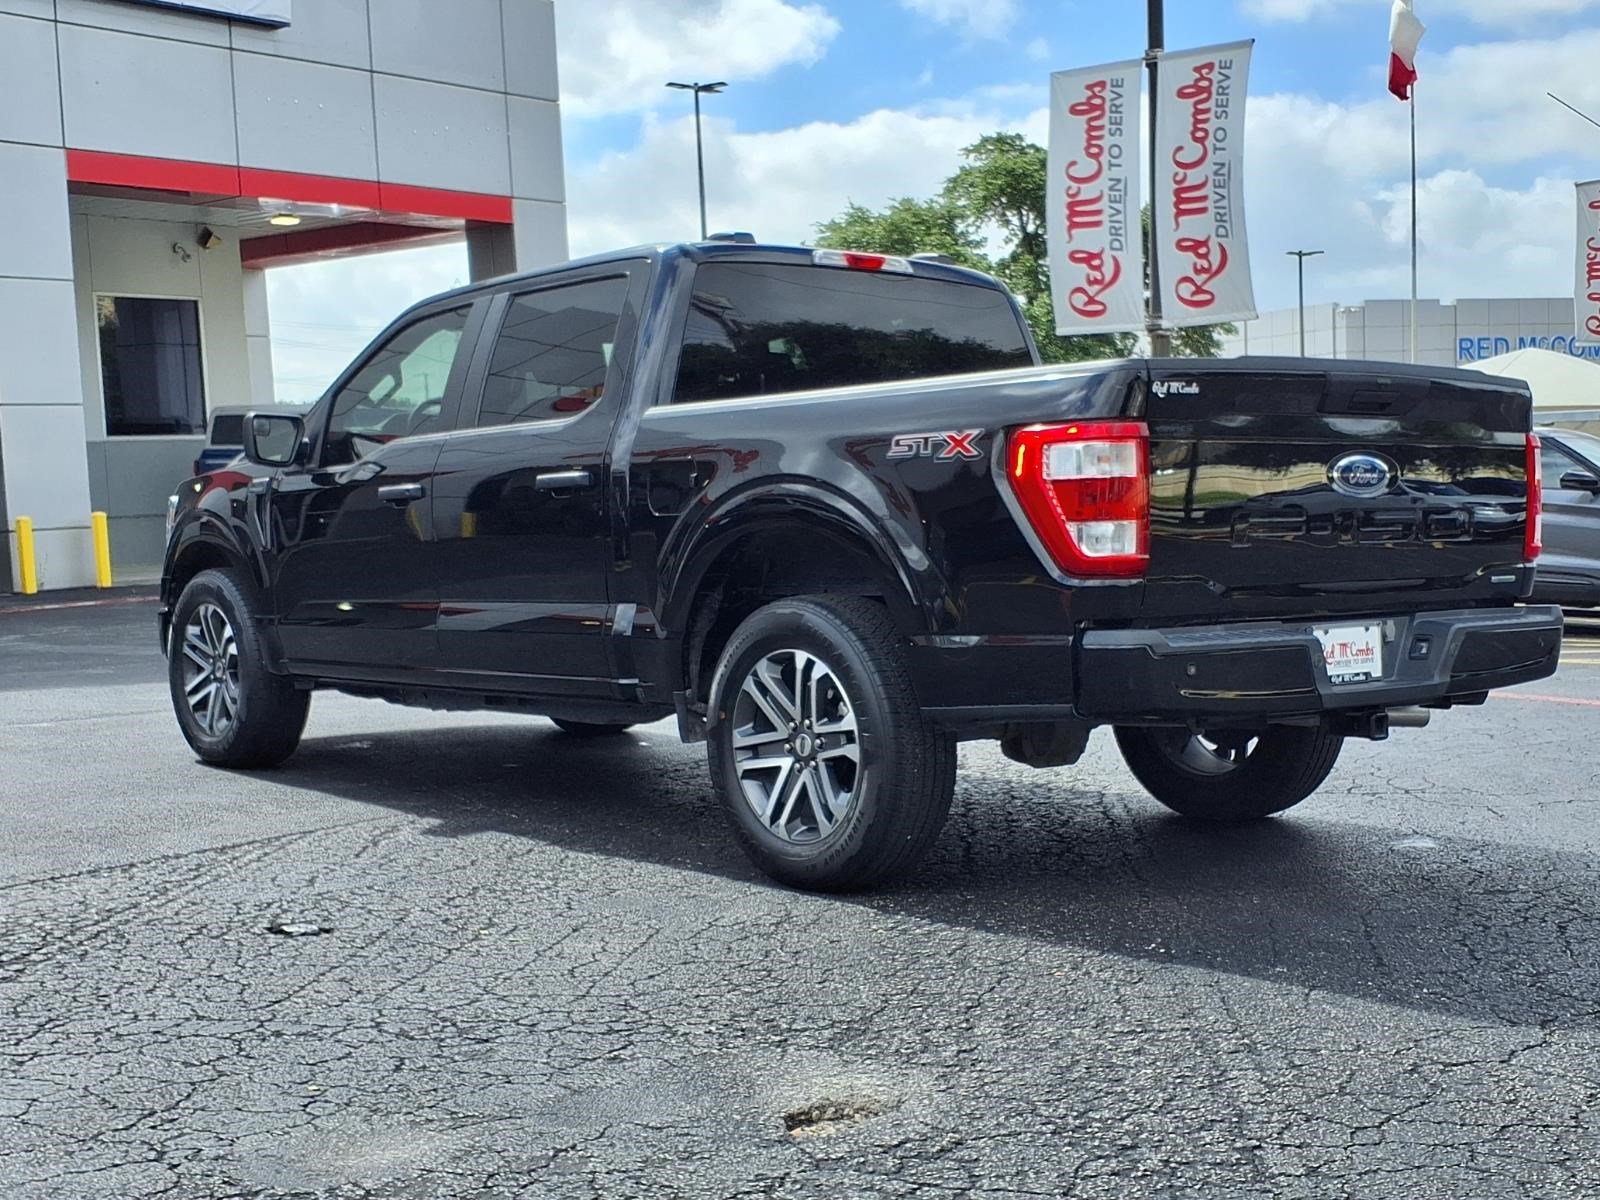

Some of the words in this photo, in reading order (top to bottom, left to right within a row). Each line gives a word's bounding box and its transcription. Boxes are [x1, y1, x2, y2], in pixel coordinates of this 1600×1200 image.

[1109, 77, 1125, 137] SERVE
[1215, 58, 1233, 120] SERVE
[1065, 79, 1107, 244] McCombs
[1109, 144, 1123, 171] TO
[1172, 61, 1216, 232] McCombs
[1212, 127, 1228, 155] TO
[1109, 177, 1125, 252] DRIVEN
[1211, 161, 1230, 239] DRIVEN
[1069, 247, 1121, 318] Red
[1175, 235, 1228, 308] Red
[1459, 337, 1510, 360] RED
[886, 428, 984, 463] STX
[1349, 463, 1379, 484] Ford
